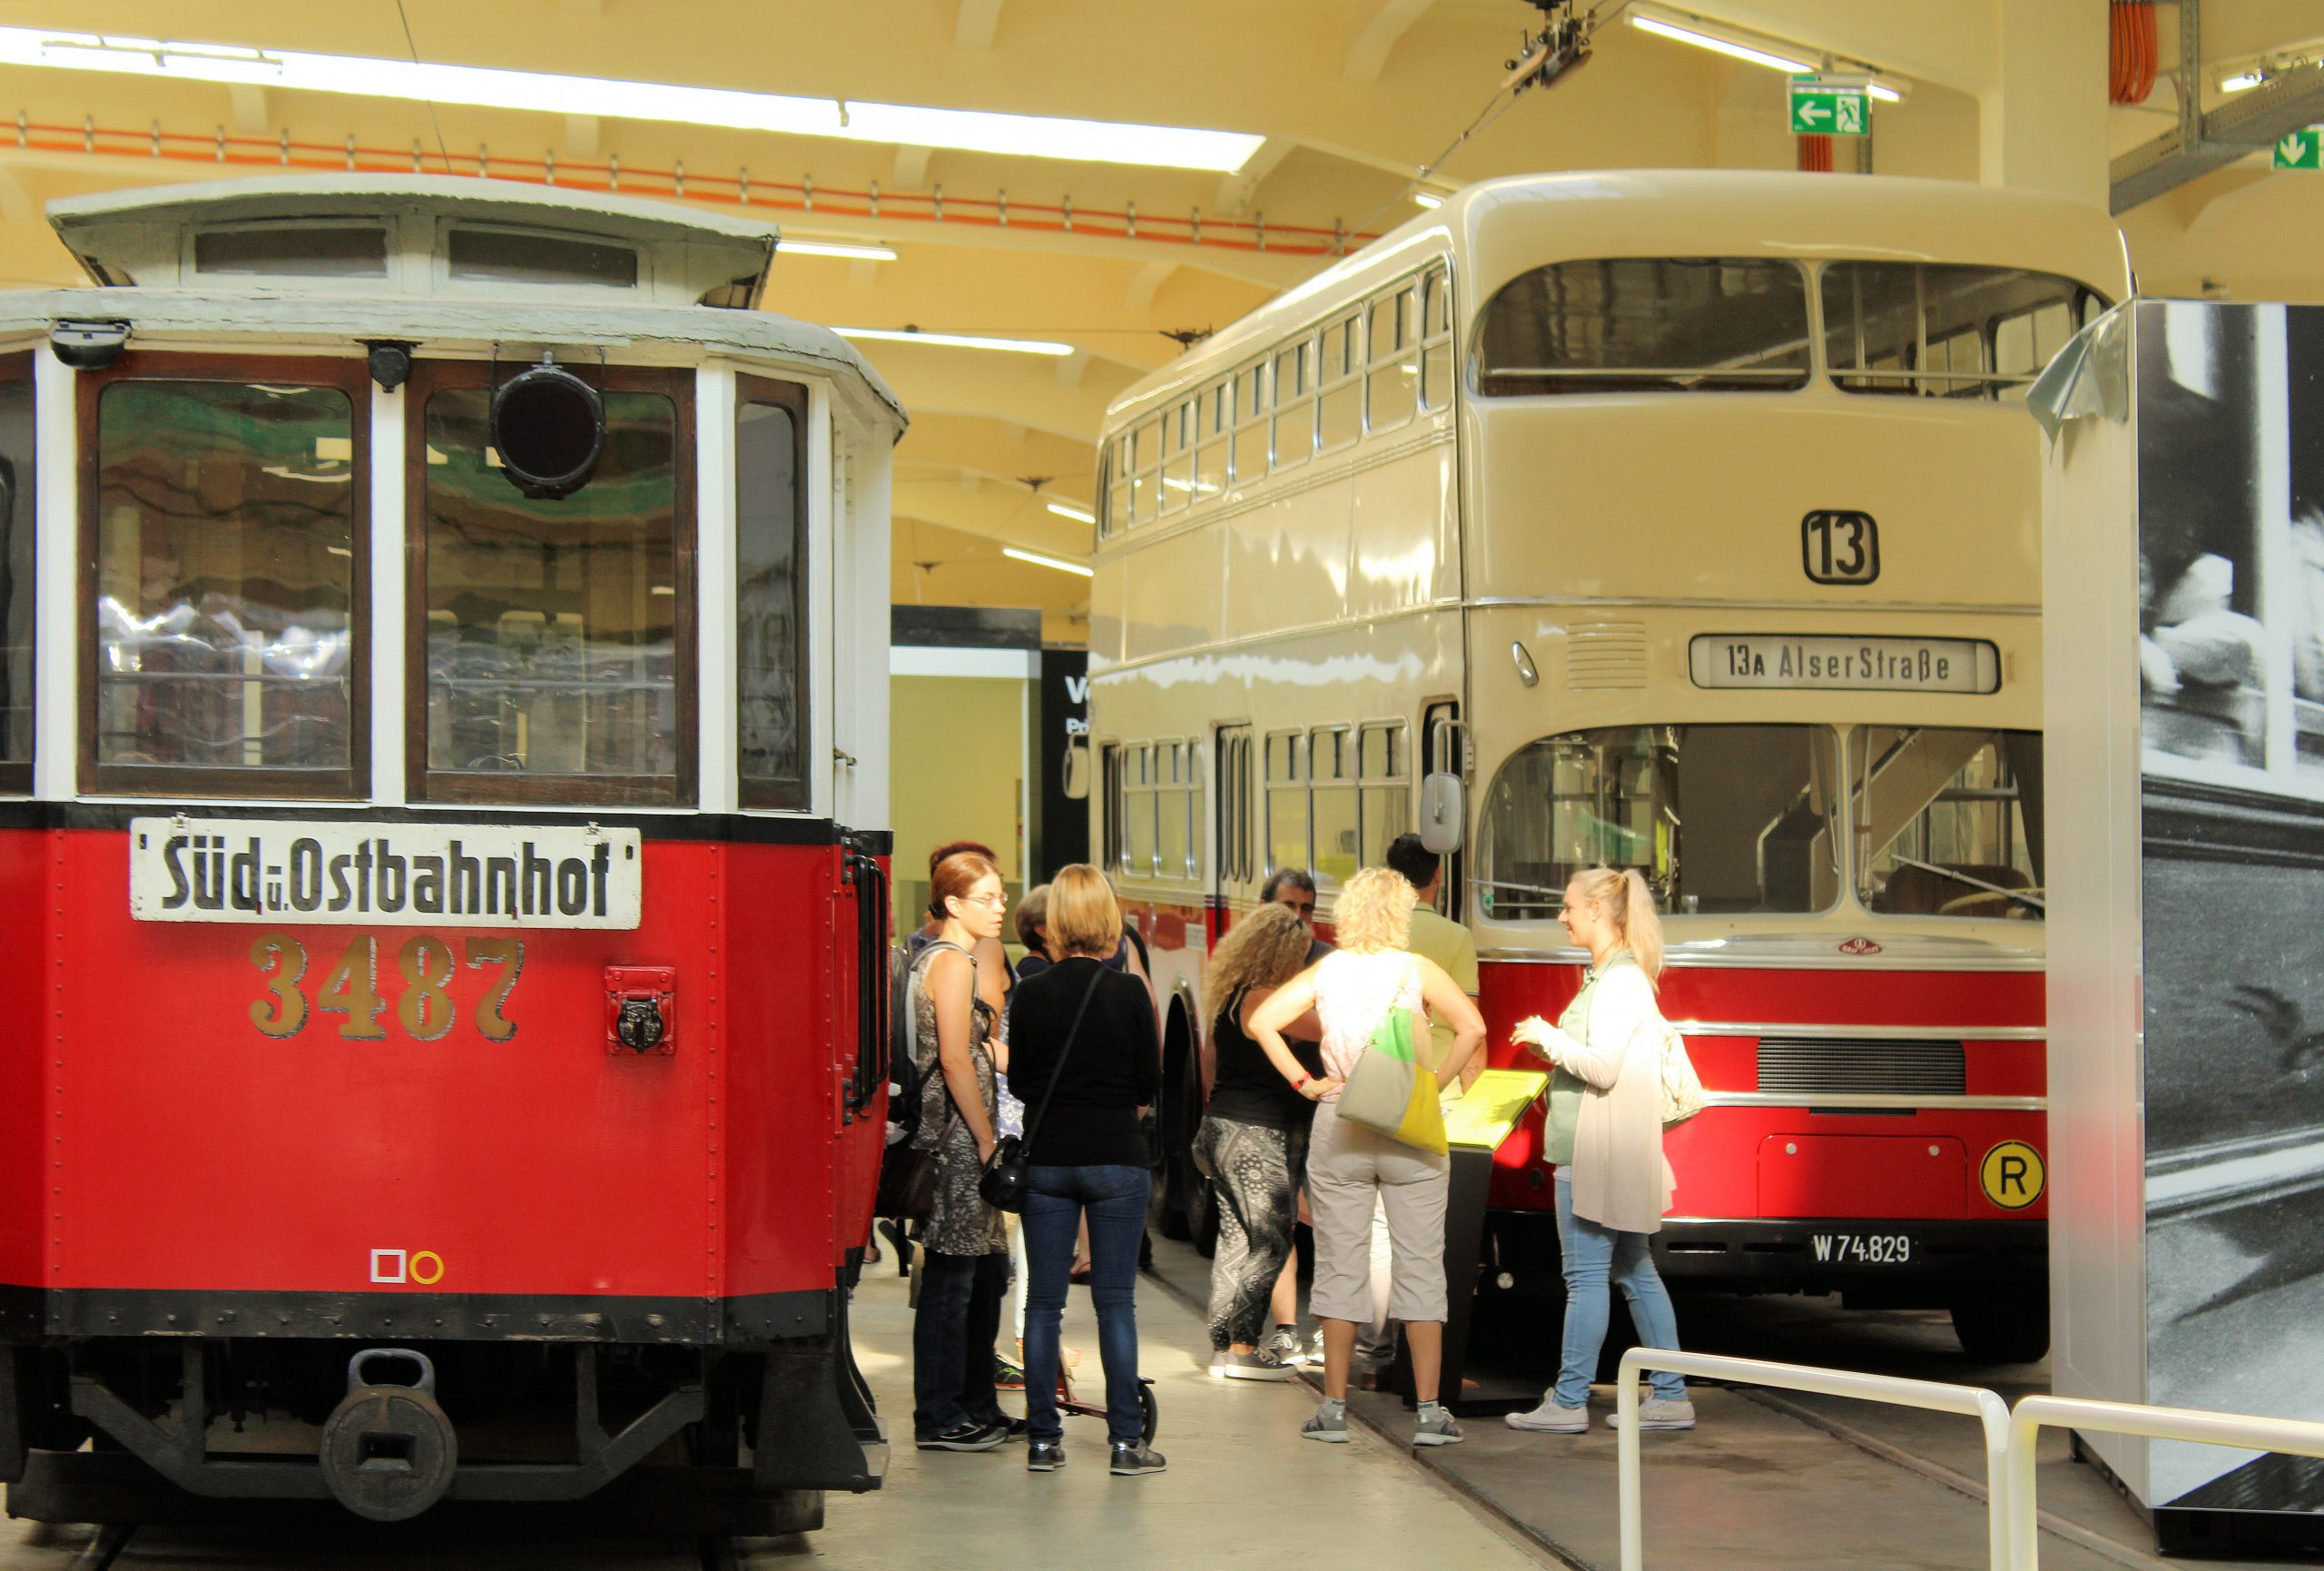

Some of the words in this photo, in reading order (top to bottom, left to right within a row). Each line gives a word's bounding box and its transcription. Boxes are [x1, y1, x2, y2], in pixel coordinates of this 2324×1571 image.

[1810, 515, 1865, 575] 13
[1728, 645, 1766, 676] 13A
[251, 934, 525, 1042] 3487
[2001, 1157, 2026, 1194] R
